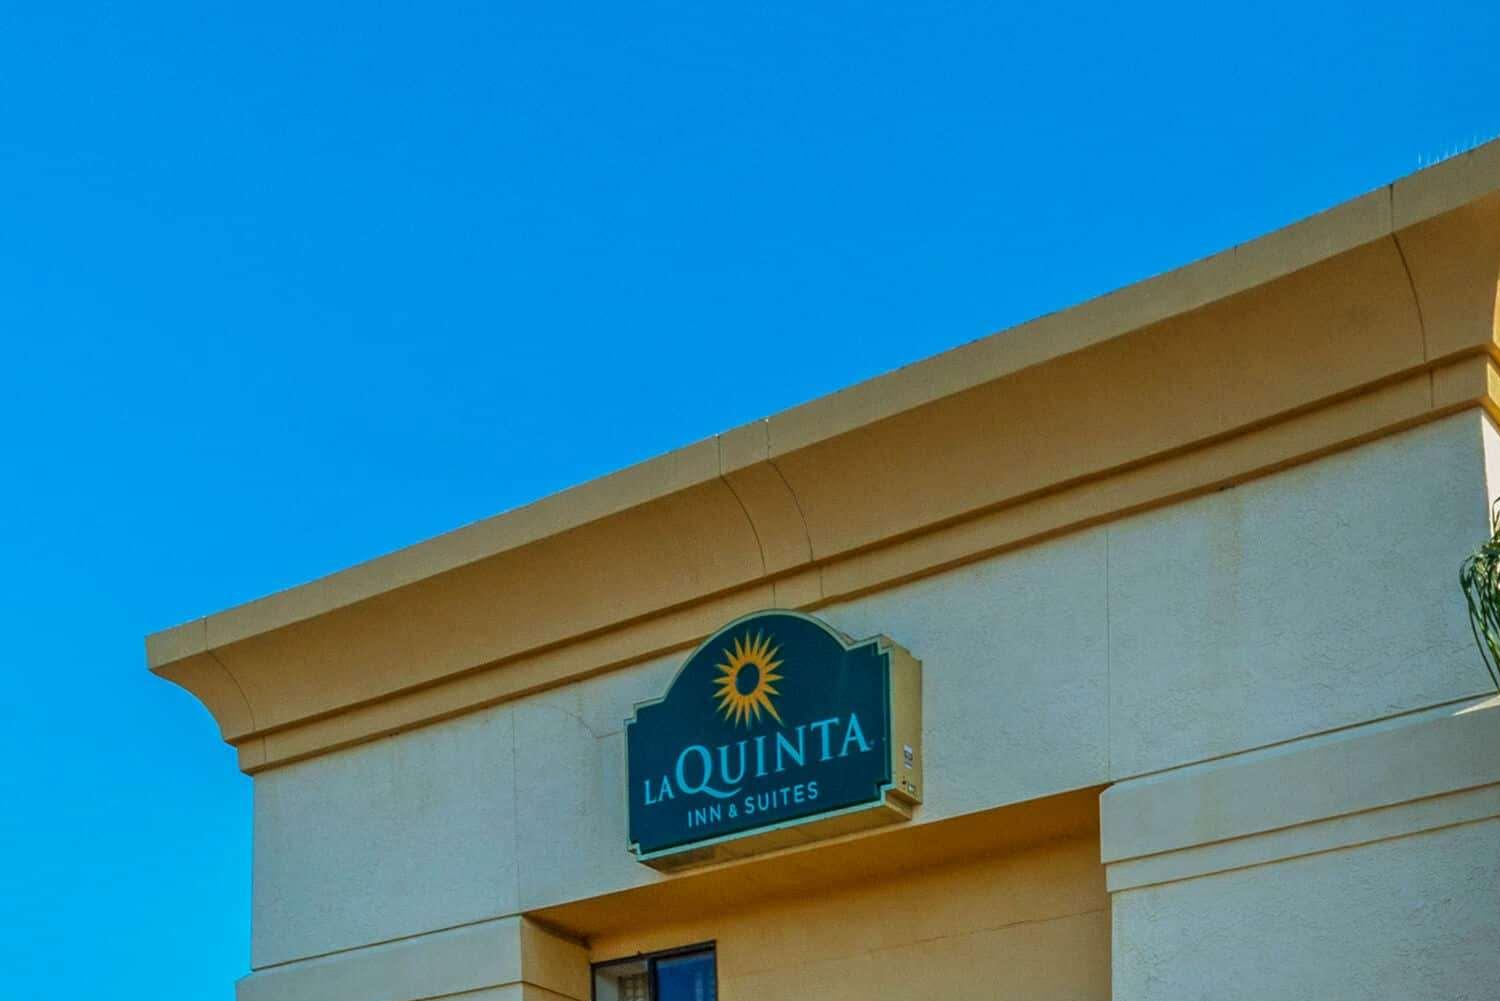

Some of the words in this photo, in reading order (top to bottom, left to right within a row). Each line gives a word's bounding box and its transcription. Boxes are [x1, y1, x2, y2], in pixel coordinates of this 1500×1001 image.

[643, 774, 675, 806] LA
[675, 712, 872, 799] QUINTA
[687, 804, 721, 828] INN
[728, 804, 738, 818] &
[744, 781, 819, 815] SUITES
